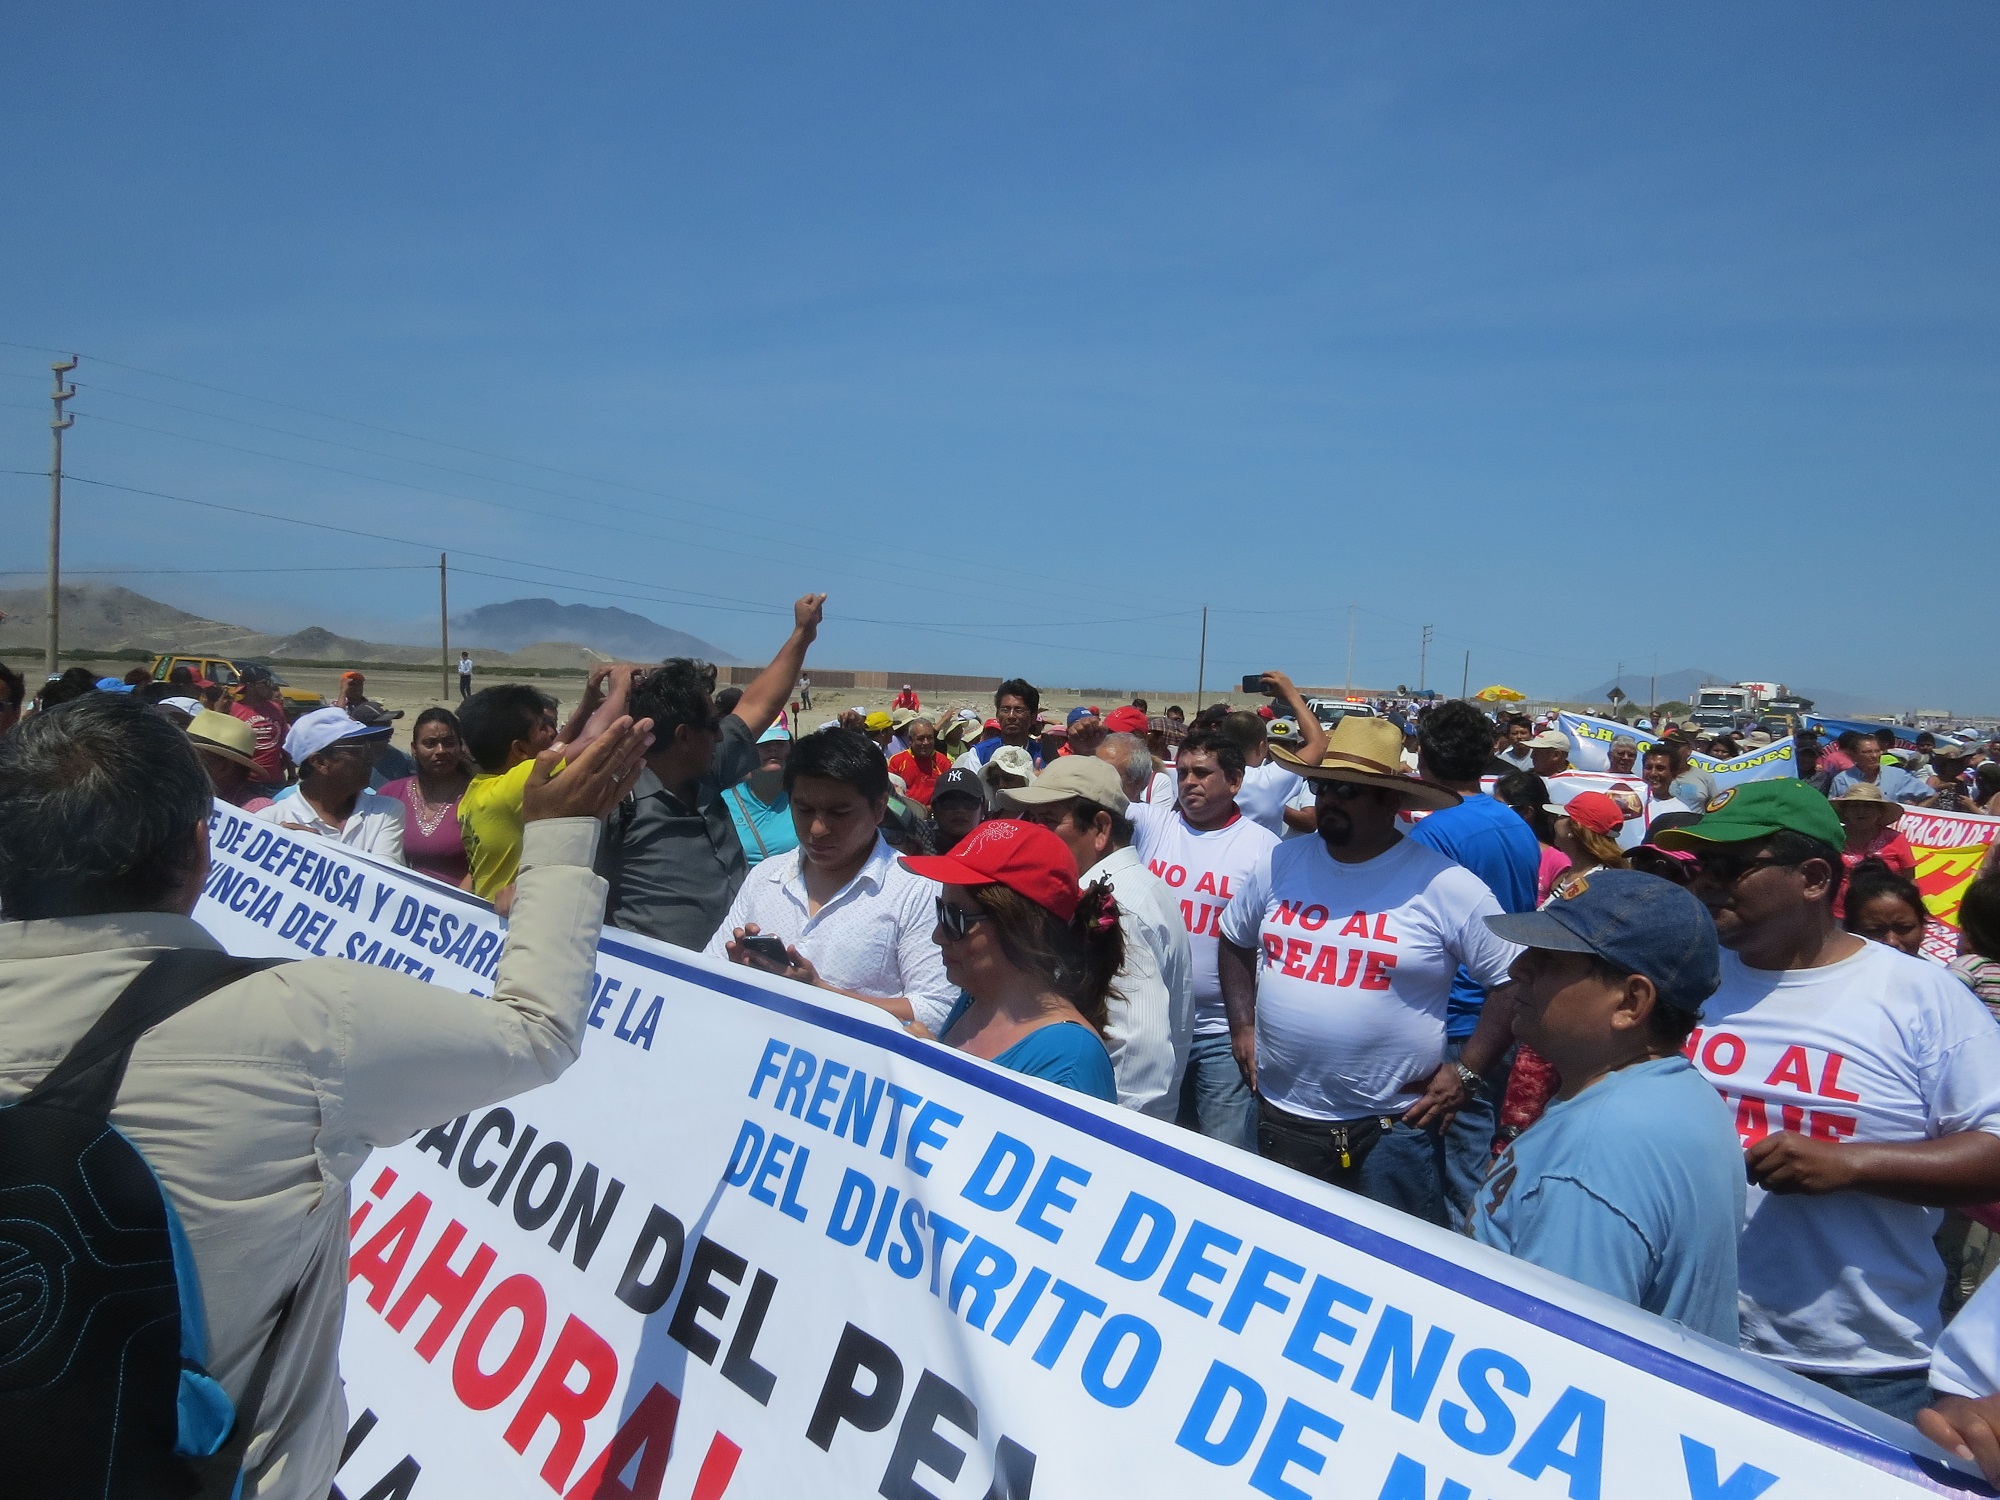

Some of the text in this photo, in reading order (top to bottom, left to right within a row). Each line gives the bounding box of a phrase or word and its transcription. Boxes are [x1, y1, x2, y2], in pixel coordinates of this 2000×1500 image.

[1147, 858, 1235, 899] NO AL
[215, 815, 253, 855] DE
[241, 828, 366, 914] DEFENSA
[368, 882, 396, 923] Y
[613, 987, 665, 1051] LA
[277, 901, 338, 957] DEL
[1270, 900, 1398, 944] NO AL
[1262, 932, 1398, 991] PEAJE
[1763, 1044, 1860, 1103] AL
[407, 1106, 626, 1273] ACION
[614, 1203, 779, 1408] DEL
[748, 1038, 965, 1179] FRENTE
[959, 1130, 1093, 1245] DE
[1095, 1190, 1607, 1500] DEFENSA
[722, 1118, 1346, 1500] DEL DISTRITO DE
